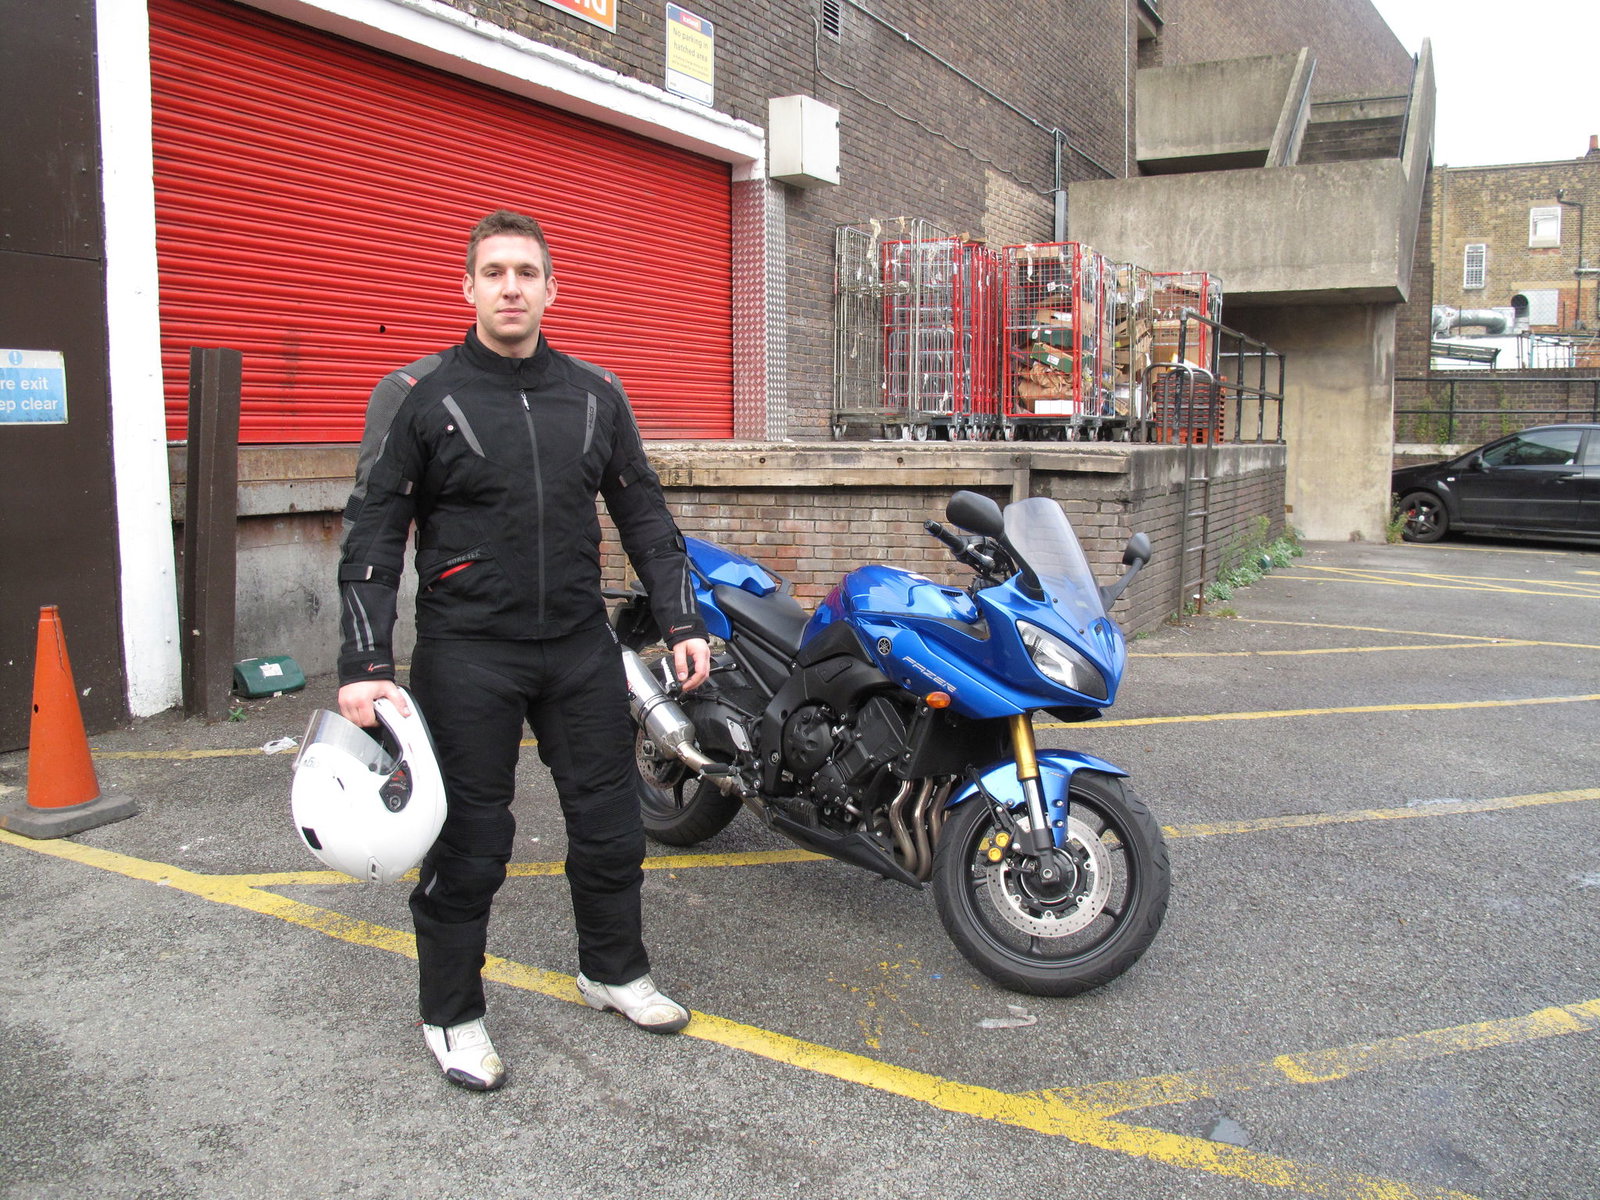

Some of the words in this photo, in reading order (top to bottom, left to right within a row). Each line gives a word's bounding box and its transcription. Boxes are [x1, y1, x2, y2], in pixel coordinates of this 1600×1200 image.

[673, 27, 681, 37] No
[682, 32, 702, 49] parking
[703, 40, 708, 49] in
[673, 40, 695, 57] hatched
[697, 53, 707, 62] area
[21, 376, 48, 390] exit
[21, 397, 58, 410] clear
